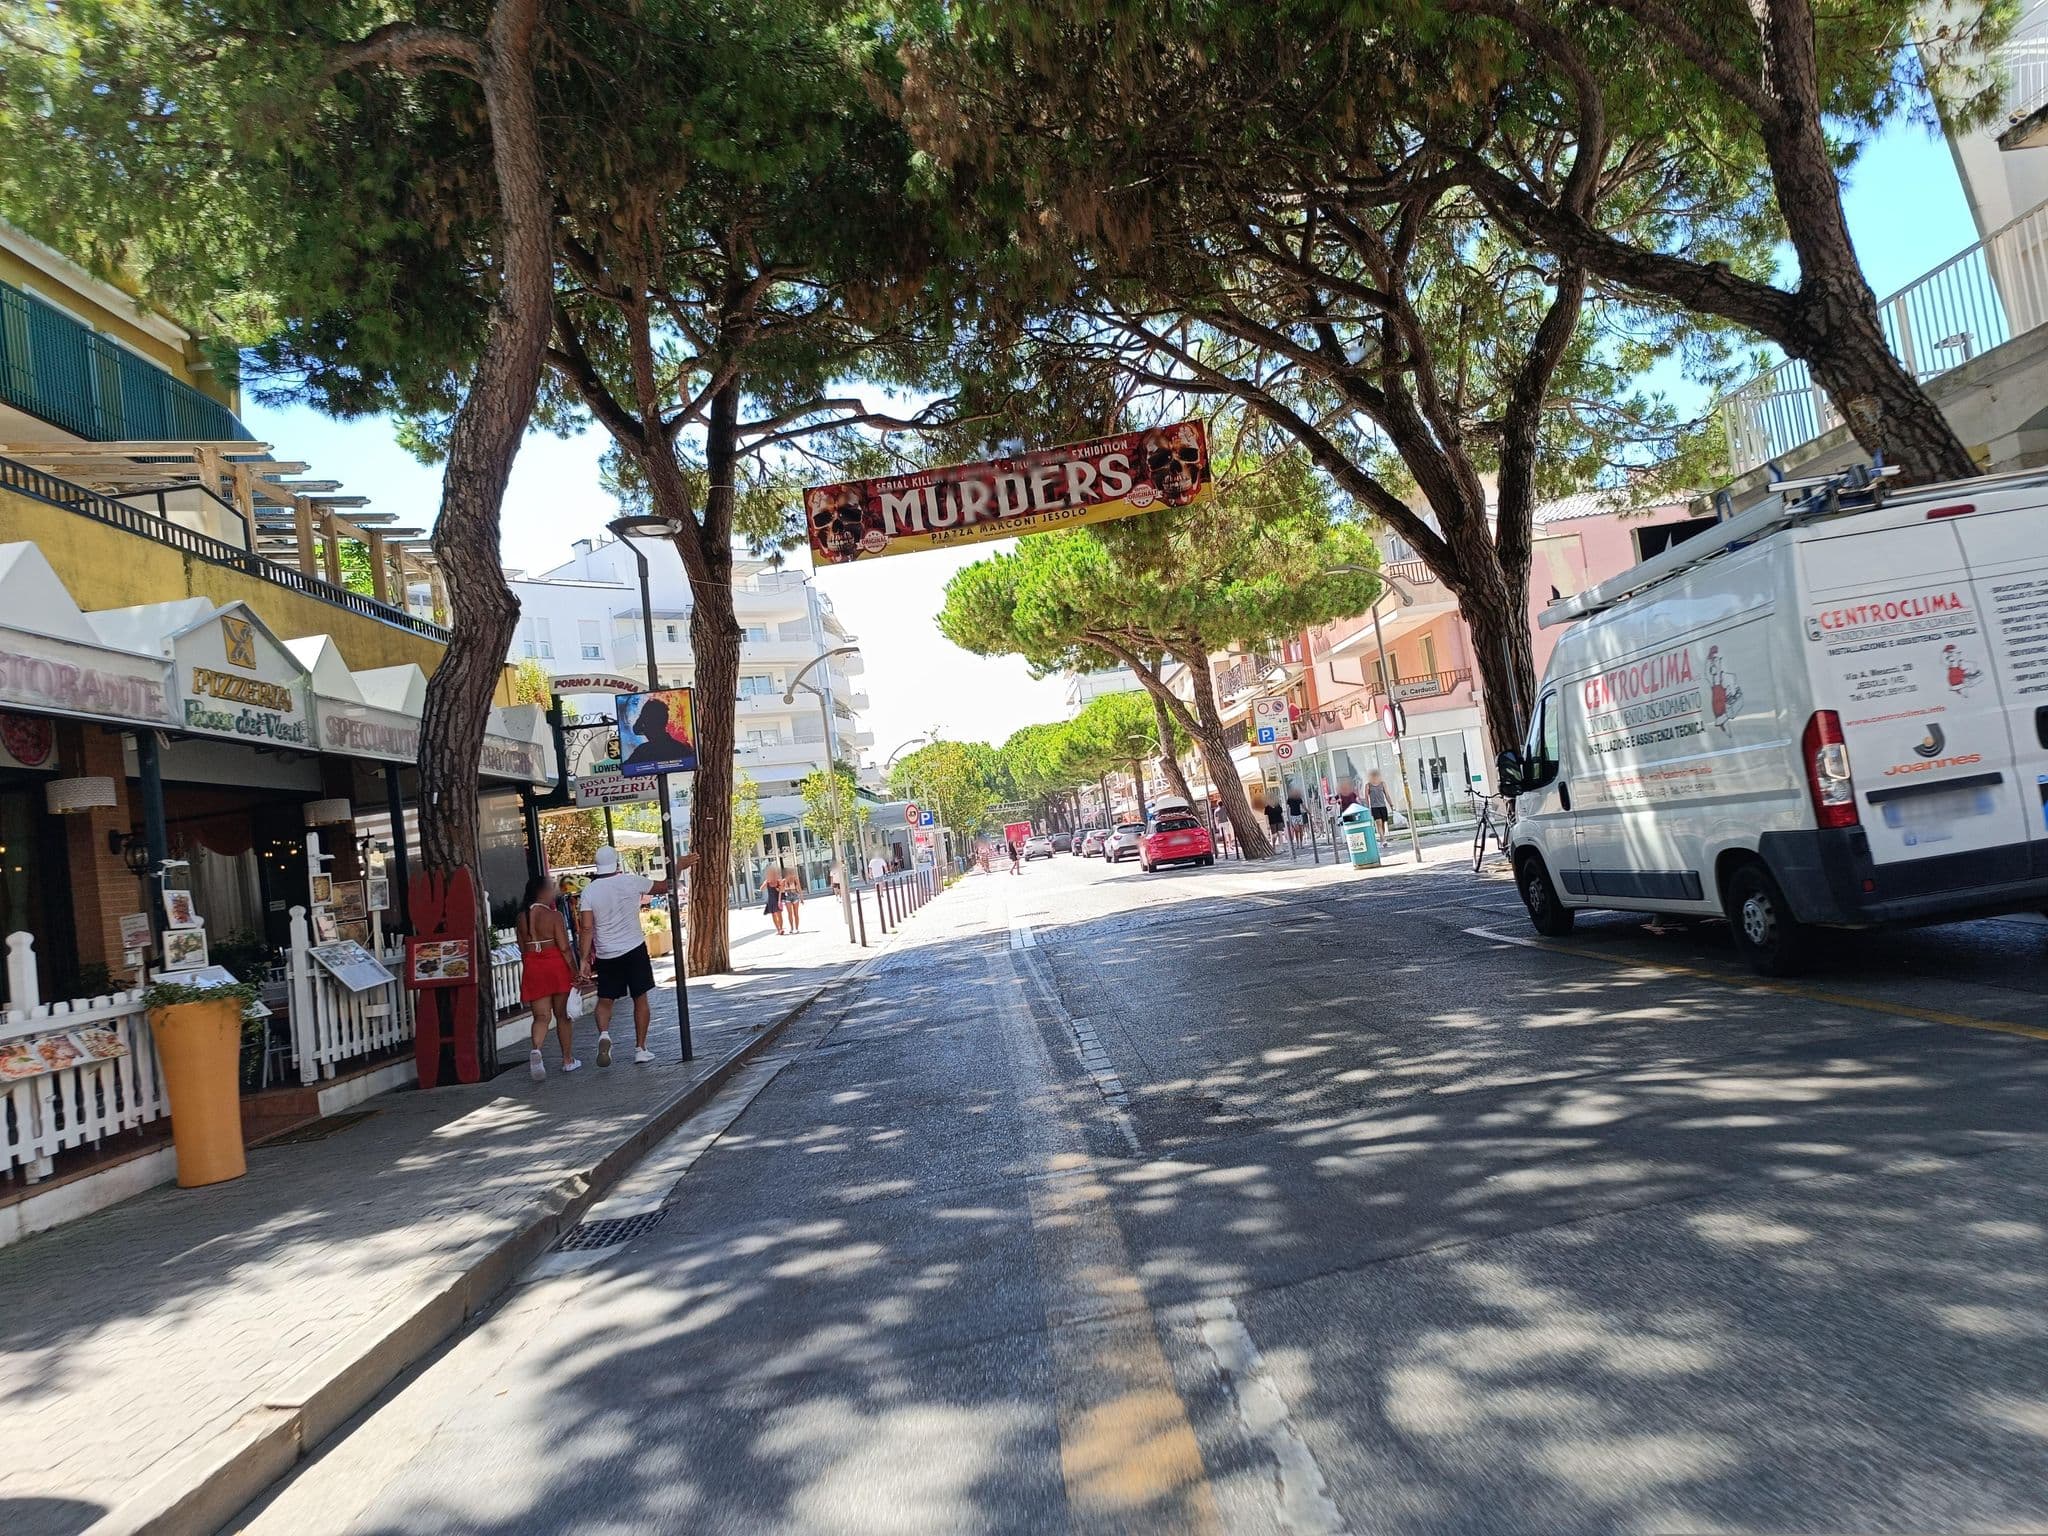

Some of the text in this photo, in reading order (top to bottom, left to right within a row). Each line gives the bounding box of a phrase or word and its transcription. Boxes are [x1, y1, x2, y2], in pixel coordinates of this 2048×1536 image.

[876, 480, 909, 492] SERIAL
[1072, 440, 1129, 459] EXHIBITION
[879, 453, 1132, 535] MURDERS
[931, 528, 974, 541] PIAZZA
[979, 517, 1036, 533] MARCONI
[1041, 508, 1088, 522] JESOLO
[1820, 592, 1963, 630] CENTROCLIMA
[592, 677, 601, 687] A
[1585, 648, 1692, 710] CENTROCLIMA
[192, 667, 293, 713] PIZZERIA
[1410, 684, 1437, 694] Carducci
[1262, 730, 1271, 741] P
[1280, 747, 1289, 755] 30
[1883, 753, 1983, 776] Joannes
[580, 778, 606, 790] ROSA
[585, 781, 656, 797] PIZZERIA
[921, 812, 930, 824] P
